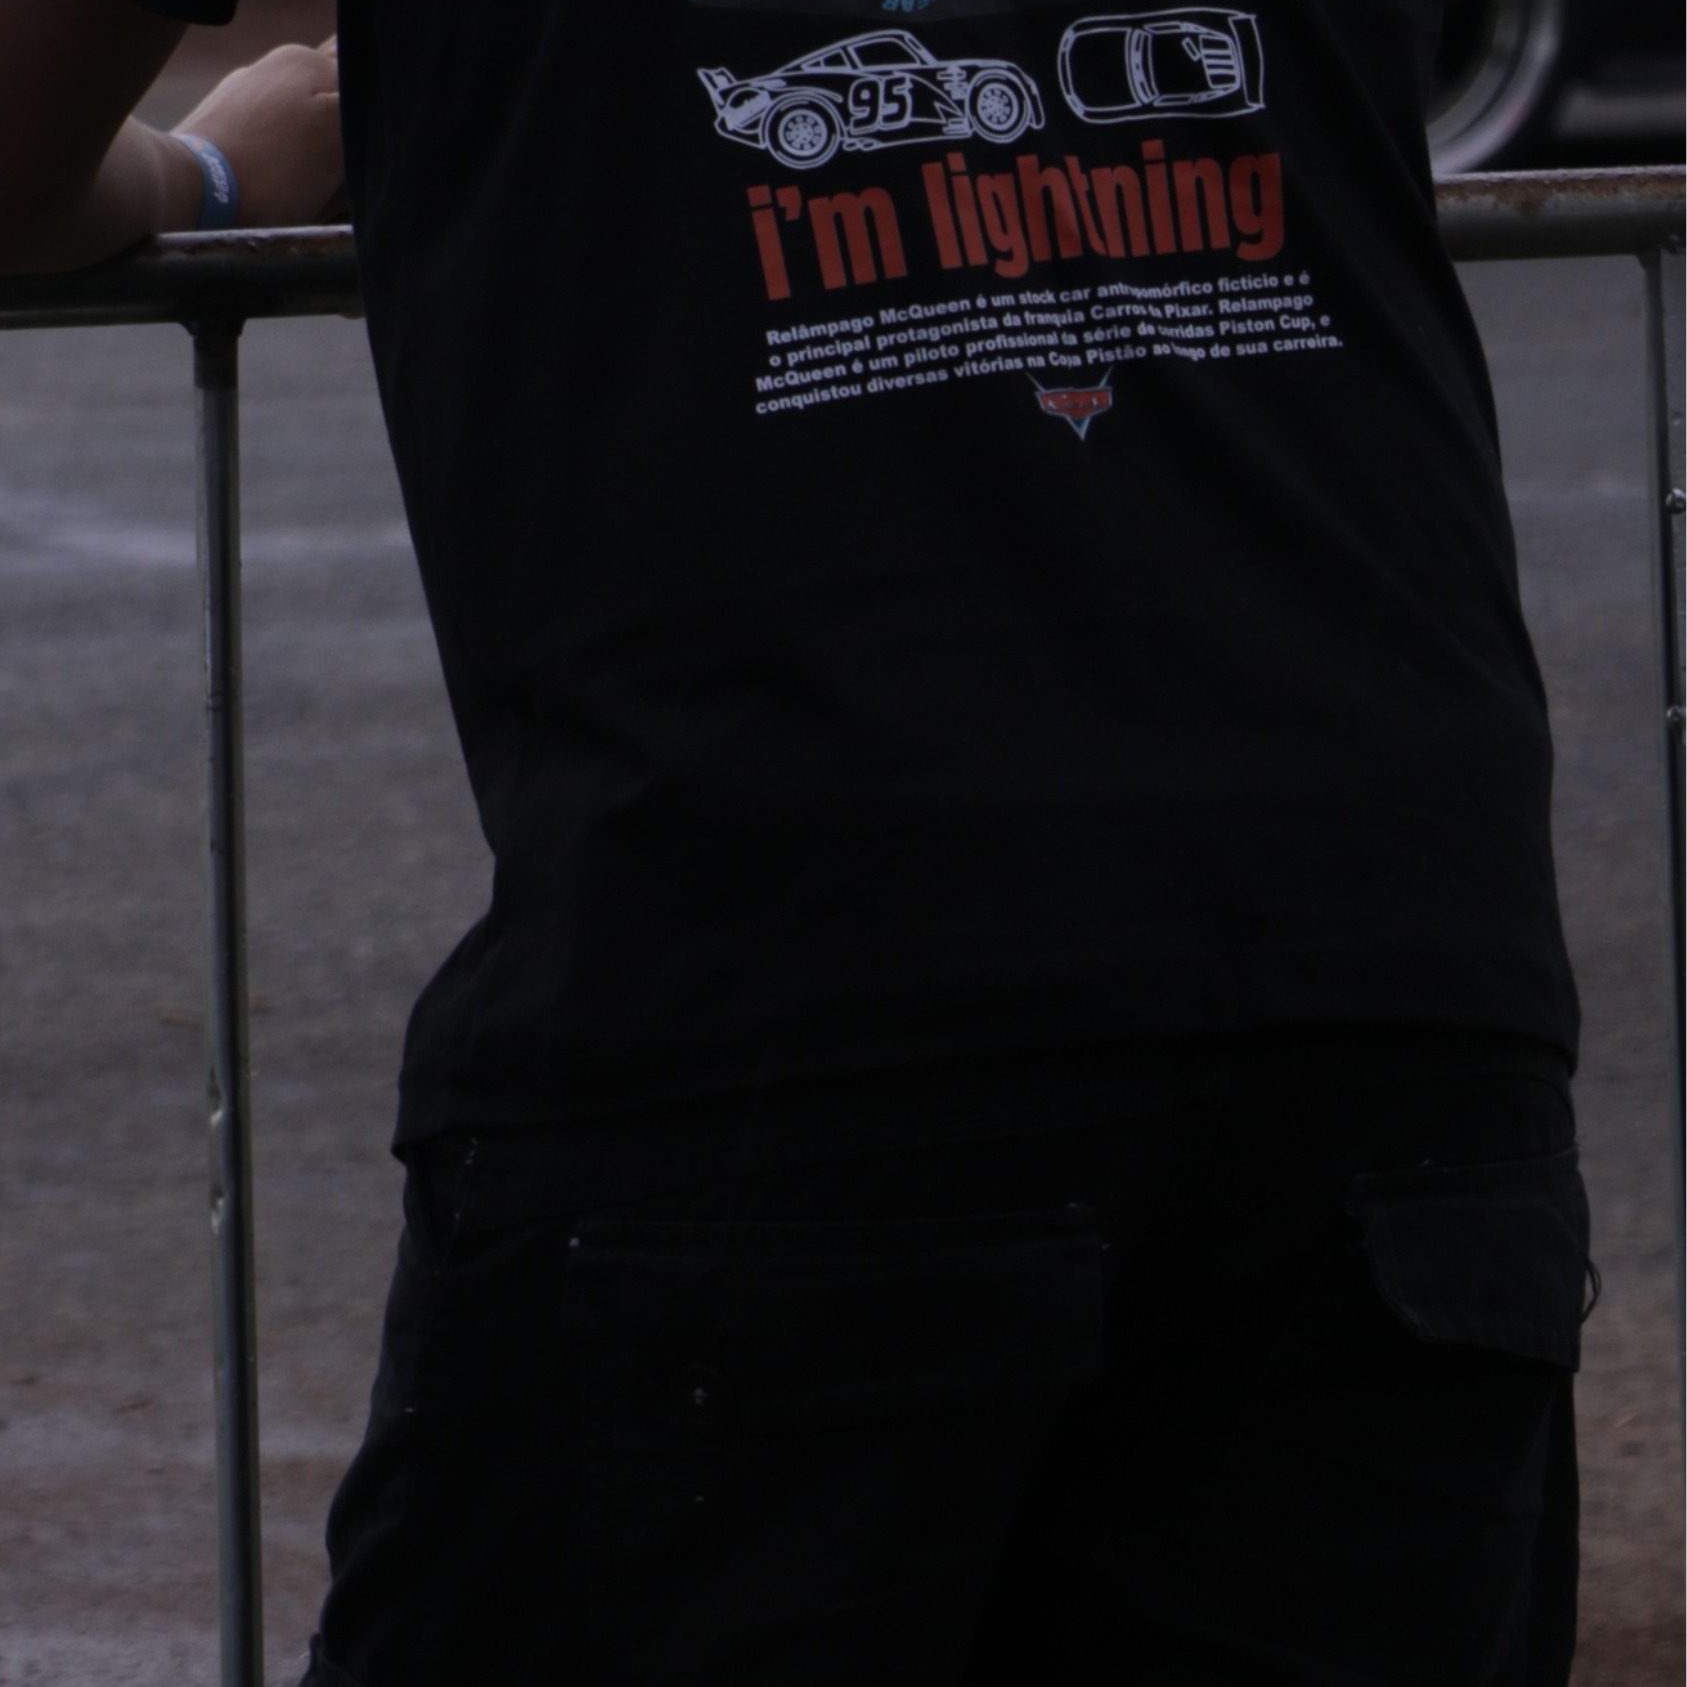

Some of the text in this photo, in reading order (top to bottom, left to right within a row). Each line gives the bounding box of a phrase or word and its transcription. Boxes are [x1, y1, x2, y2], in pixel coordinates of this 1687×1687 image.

[848, 75, 914, 135] 95
[746, 138, 1286, 301] i'm lightning
[766, 315, 875, 346] Relâmpago
[879, 298, 972, 325] McQueen
[975, 293, 988, 309] é
[990, 294, 1016, 307] um
[1018, 289, 1057, 305] stock
[1059, 287, 1091, 303] car
[1283, 274, 1294, 286] e
[1298, 269, 1310, 285] é
[769, 355, 782, 367] o
[786, 334, 872, 366] principal
[876, 316, 998, 351] protagonista
[1002, 312, 1022, 327] da
[1023, 308, 1086, 328] franquia
[1164, 303, 1214, 319] Pixar.
[755, 364, 847, 393] McQueen
[851, 357, 864, 374] é
[868, 355, 899, 371] um
[903, 343, 960, 369] piloto
[965, 330, 1060, 358] profissional
[1083, 324, 1131, 344] série
[1137, 320, 1156, 336] de
[1219, 318, 1276, 336] Piston
[1279, 313, 1316, 332] Cup,
[1319, 314, 1331, 327] e
[755, 383, 863, 415] conquistou
[866, 368, 949, 393] diversas
[953, 356, 1024, 378] vitórias
[1026, 355, 1046, 368] na
[1085, 343, 1147, 365] Pistão
[1153, 343, 1171, 356] ao
[1210, 342, 1231, 358] de
[1236, 341, 1269, 356] sua
[1273, 333, 1343, 352] carreira.
